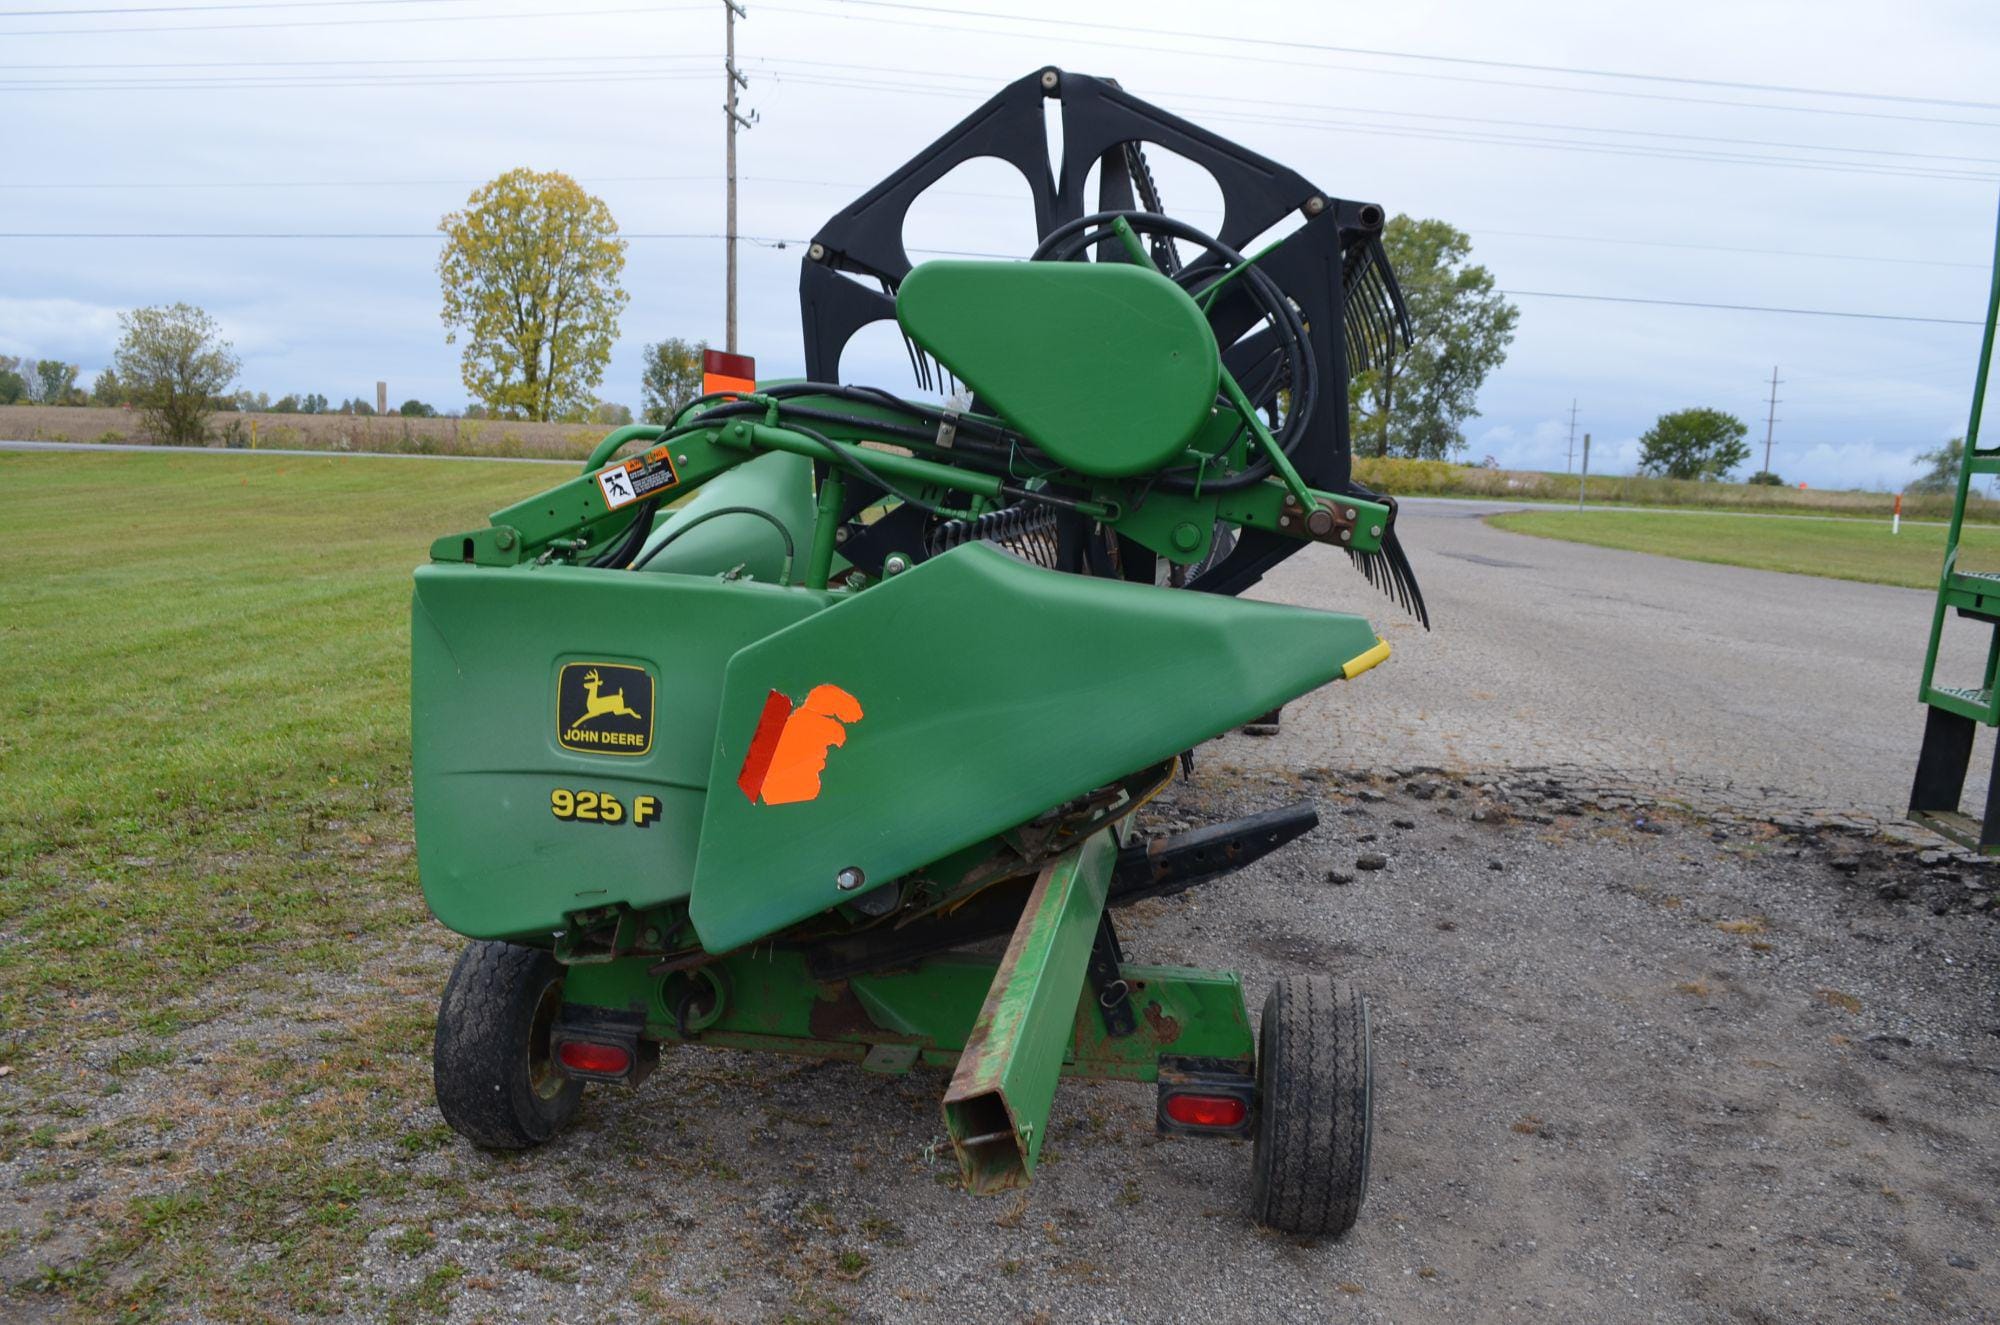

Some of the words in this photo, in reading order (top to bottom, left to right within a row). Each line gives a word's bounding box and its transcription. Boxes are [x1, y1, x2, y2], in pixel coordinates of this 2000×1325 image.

[563, 729, 599, 743] JOHN
[601, 731, 644, 747] DEERE
[551, 788, 626, 824] 925
[633, 795, 662, 828] F
